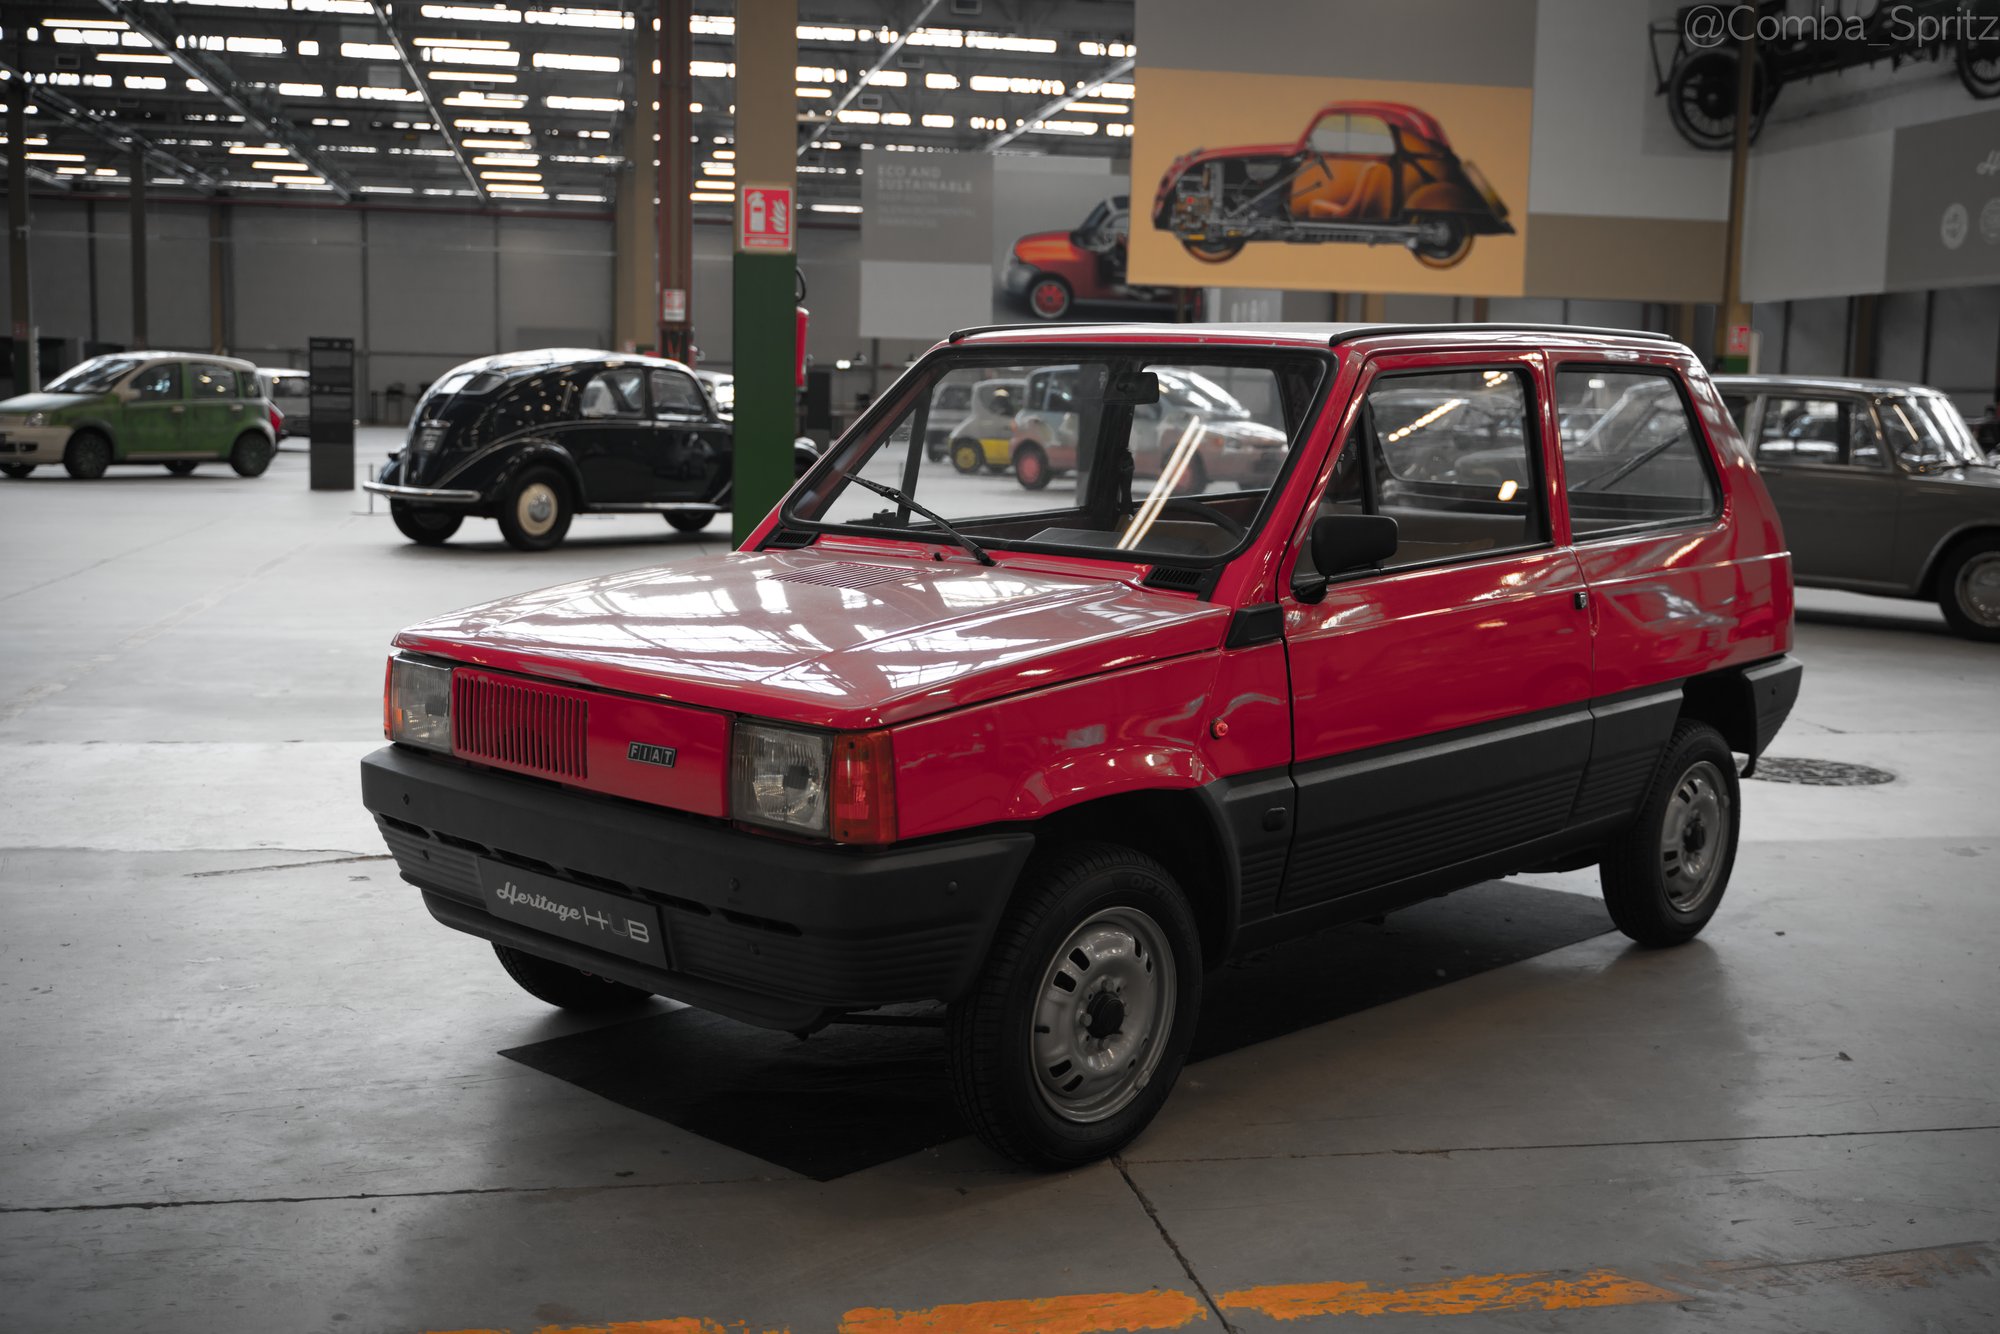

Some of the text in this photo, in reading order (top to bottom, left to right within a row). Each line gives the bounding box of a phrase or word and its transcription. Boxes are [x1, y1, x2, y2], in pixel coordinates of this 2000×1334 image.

[878, 164, 941, 178] ECO AND
[878, 178, 972, 194] SUSTAINABLE
[630, 744, 673, 764] FIAT
[496, 881, 649, 943] Heritage HUB
